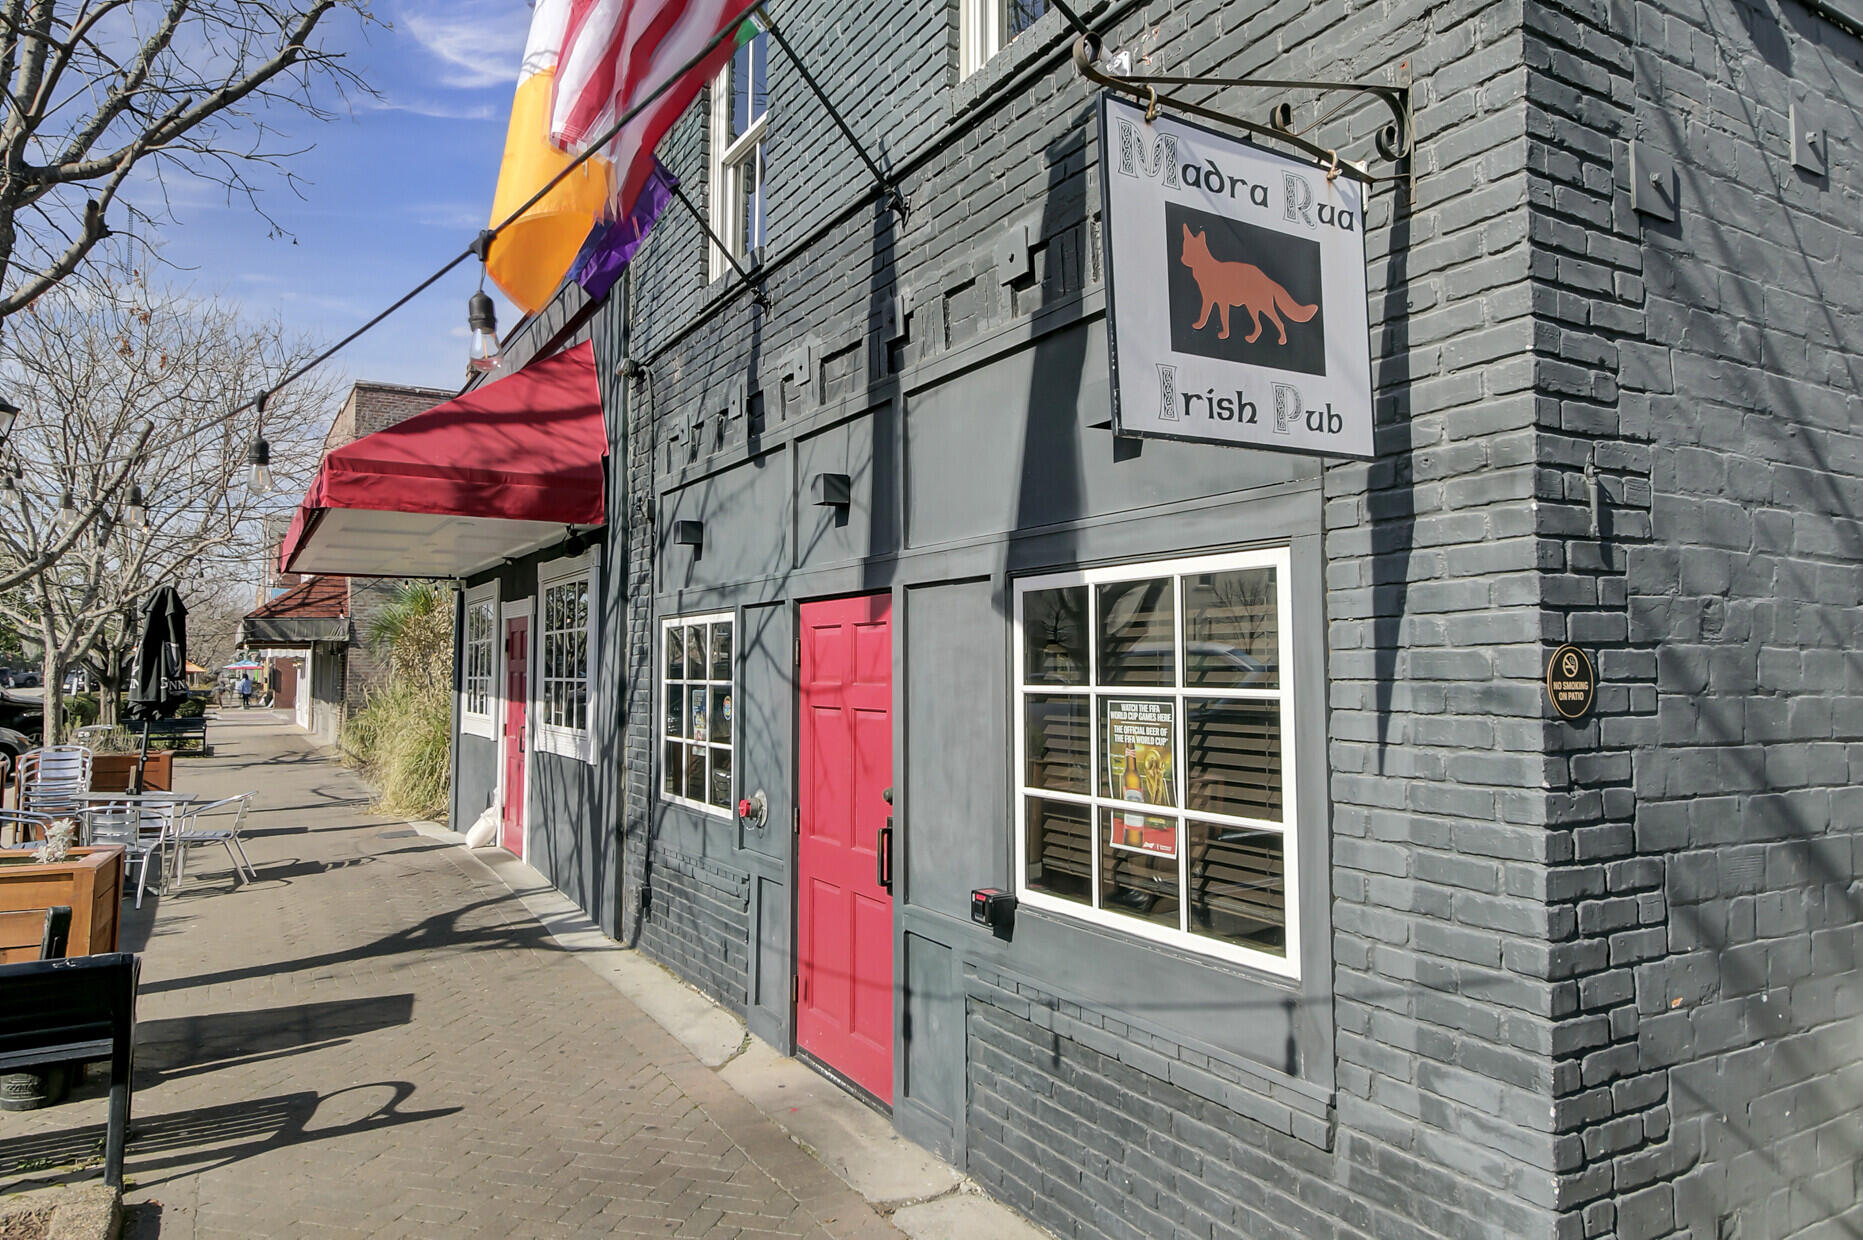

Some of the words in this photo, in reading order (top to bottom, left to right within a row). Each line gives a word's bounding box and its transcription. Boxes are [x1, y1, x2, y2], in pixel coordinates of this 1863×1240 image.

[1116, 117, 1269, 209] Madra
[1281, 169, 1355, 232] Rua
[1156, 363, 1257, 424] Irish
[1271, 381, 1343, 435] Pub
[1553, 682, 1562, 690] NO
[1563, 682, 1588, 690] SMOKING
[1559, 692, 1568, 700] ON
[1568, 692, 1584, 700] PATIO
[1121, 704, 1138, 712] WATCH
[1139, 704, 1149, 712] THE
[1149, 705, 1160, 713] FIFA
[1110, 711, 1127, 720] WORLD
[1128, 712, 1138, 720] CUP
[1139, 713, 1156, 721] GAMES
[1114, 725, 1123, 733] THE
[1124, 726, 1145, 735] OFFICIAL
[1146, 727, 1159, 736] BEER
[1160, 728, 1168, 736] OF
[1114, 734, 1124, 742] THE
[1125, 735, 1135, 743] FIFA
[1136, 736, 1154, 745] WORLD
